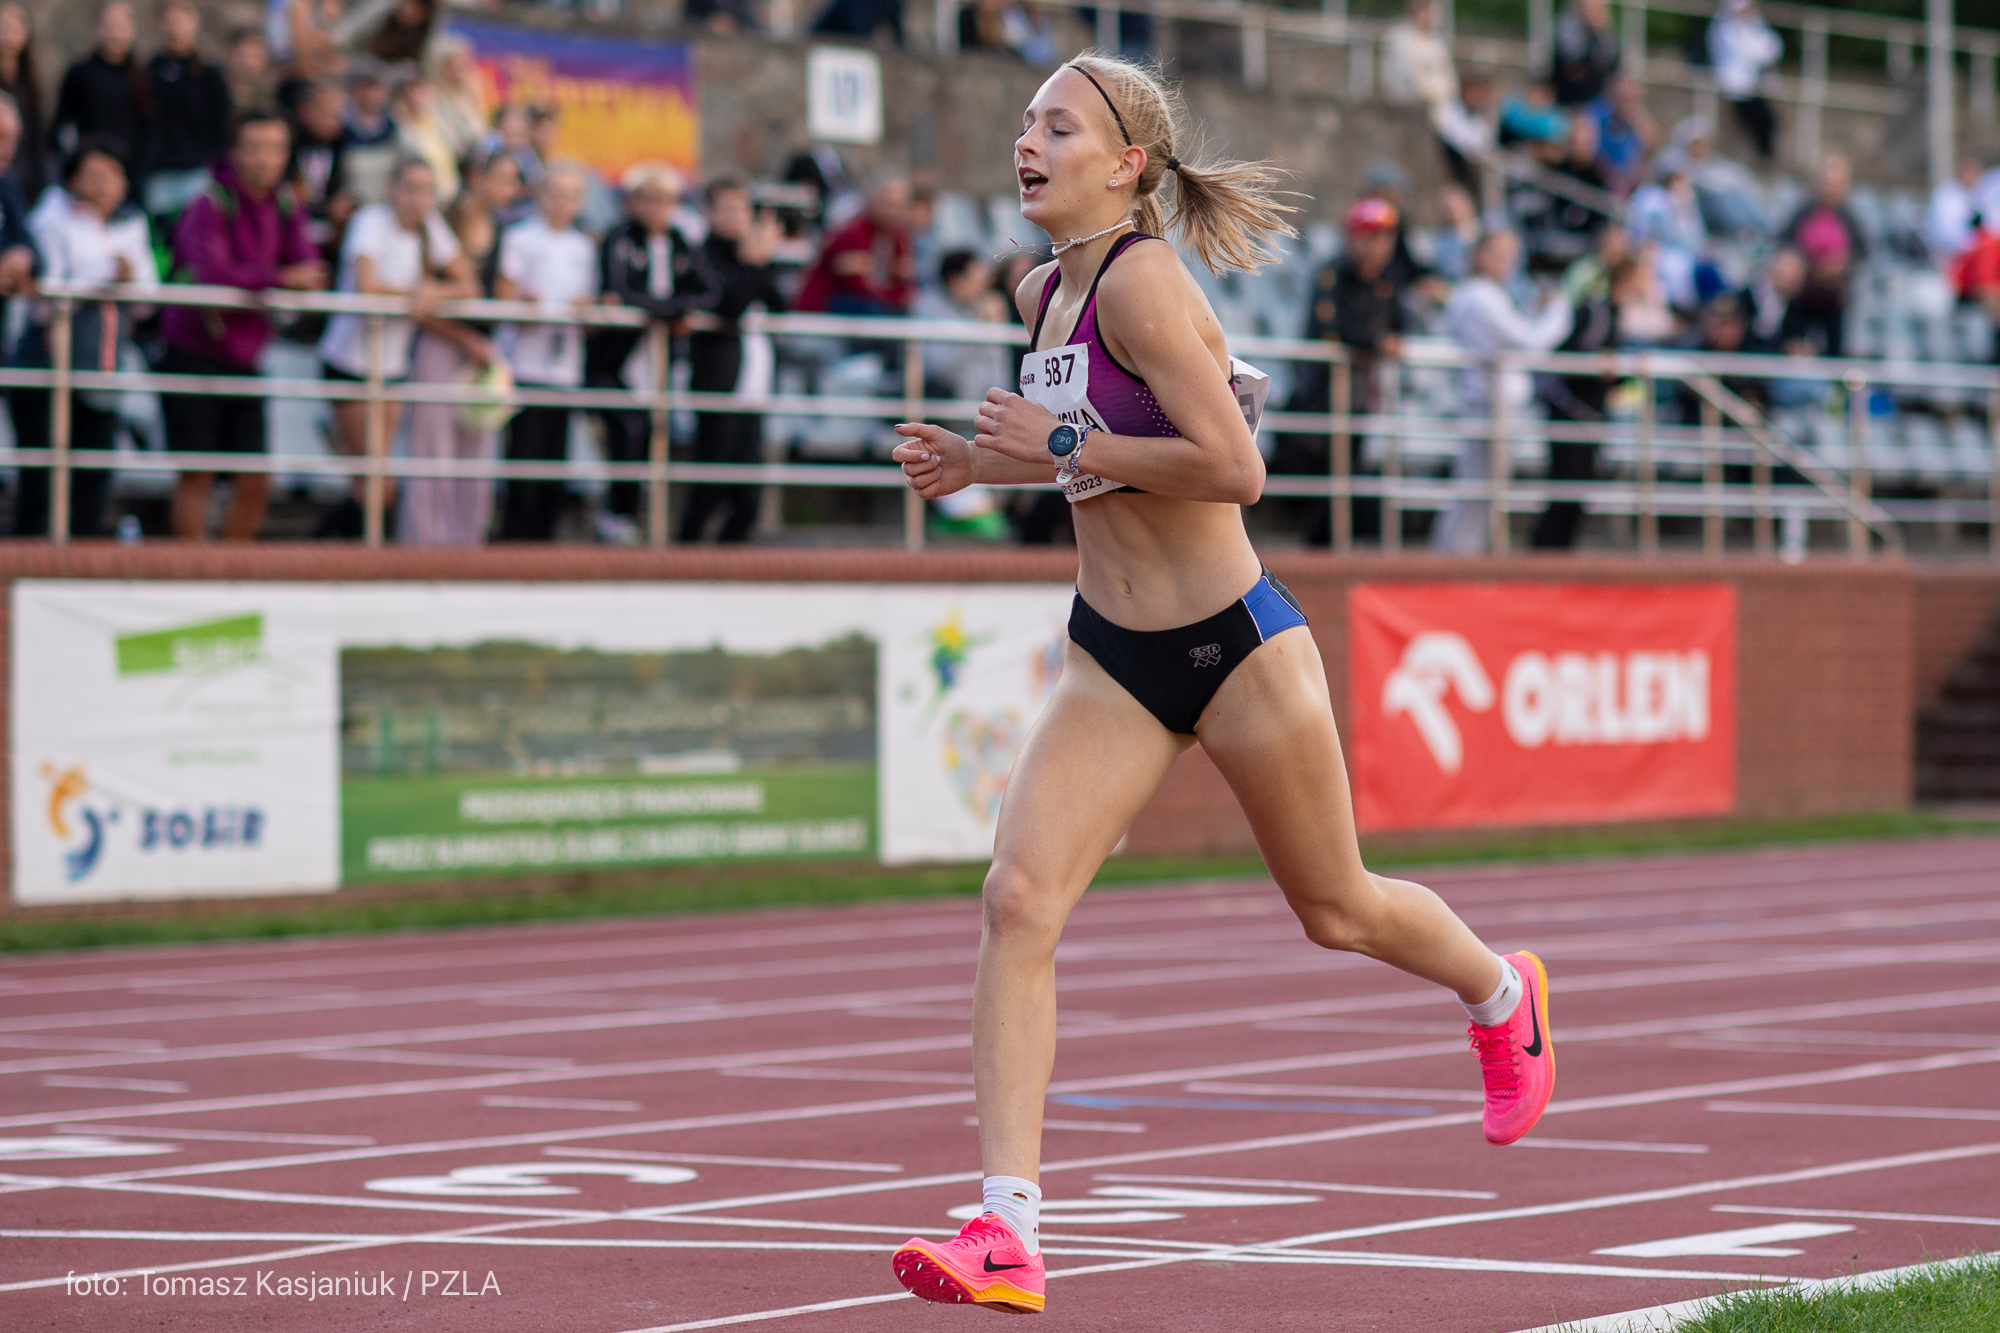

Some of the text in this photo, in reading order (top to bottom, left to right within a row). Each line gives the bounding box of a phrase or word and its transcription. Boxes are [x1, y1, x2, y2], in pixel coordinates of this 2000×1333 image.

[1045, 353, 1075, 388] 587
[1073, 476, 1102, 494] 2023
[1503, 650, 1711, 750] ORLEN
